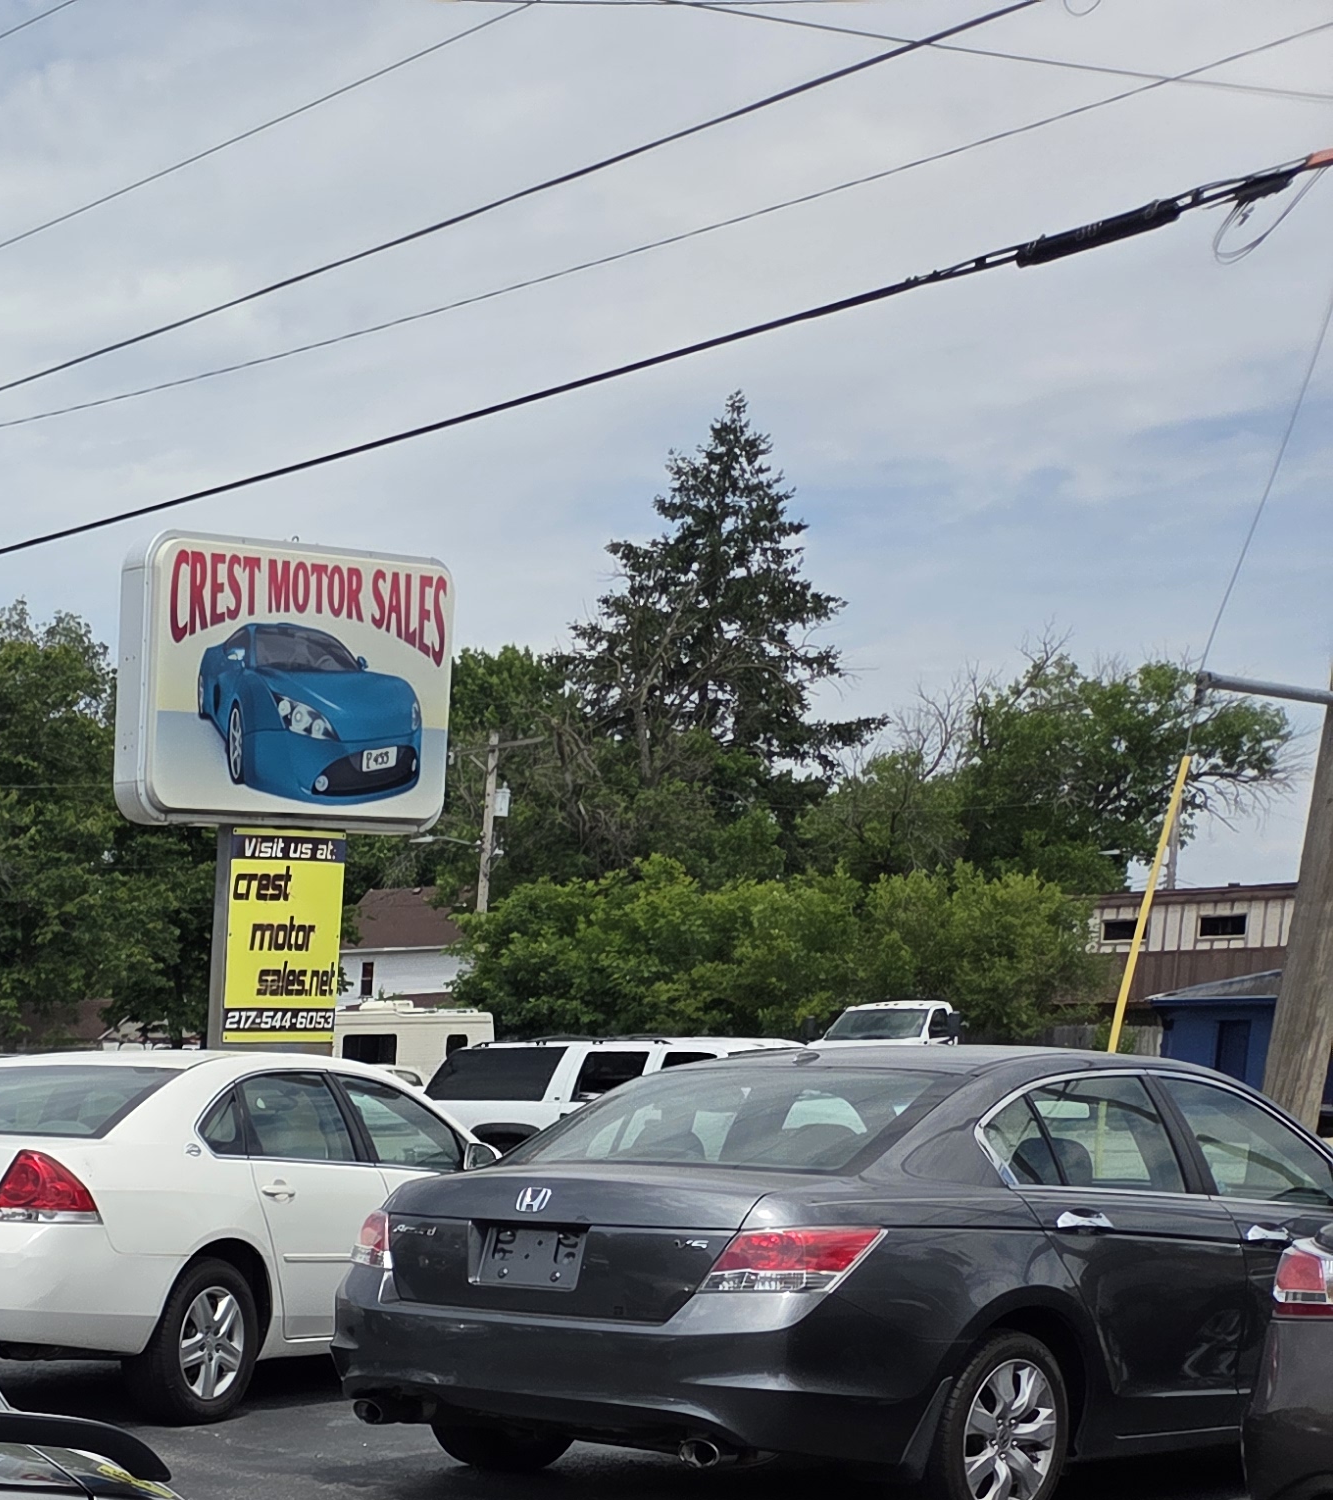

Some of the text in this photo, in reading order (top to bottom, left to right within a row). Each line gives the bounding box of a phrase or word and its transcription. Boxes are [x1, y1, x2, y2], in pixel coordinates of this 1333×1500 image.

[170, 549, 447, 667] CREST MOTOR SALES
[244, 838, 336, 860] Visit us at:
[233, 866, 292, 901] crest
[249, 915, 316, 952] motor
[256, 960, 335, 997] sales.net
[225, 1011, 333, 1030] 217-544-6053
